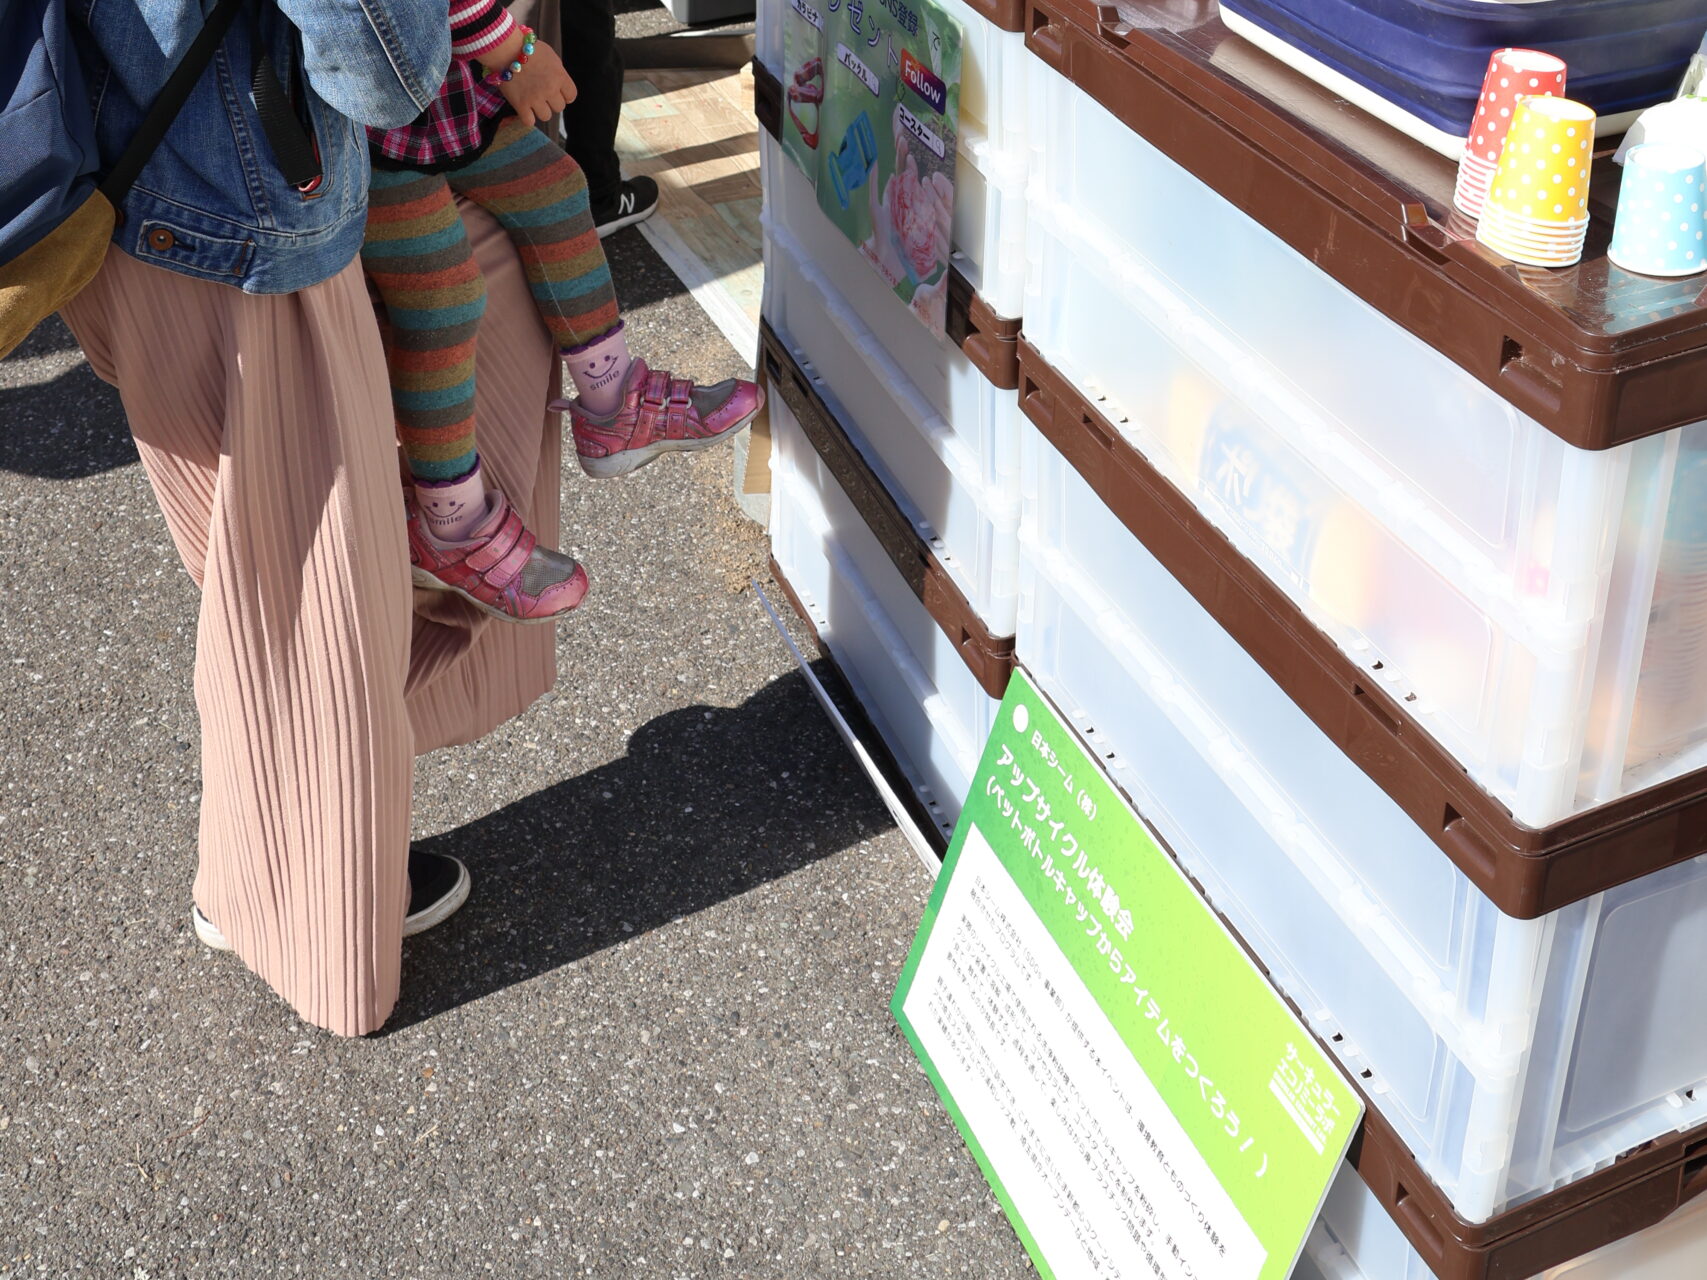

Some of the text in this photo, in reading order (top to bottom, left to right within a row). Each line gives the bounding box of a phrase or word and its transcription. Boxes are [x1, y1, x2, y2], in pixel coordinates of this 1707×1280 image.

[844, 52, 867, 83] バックル
[905, 63, 941, 104] Follow
[899, 107, 931, 141] コースター
[618, 193, 635, 214] N
[590, 370, 620, 391] smile
[429, 515, 463, 525] smile
[1032, 730, 1097, 820] 日本シーム（株）
[997, 744, 1134, 941] アップサイクル体験会
[1277, 1058, 1335, 1134] エコノミーラボ
[1286, 1043, 1340, 1115] サーキュラー
